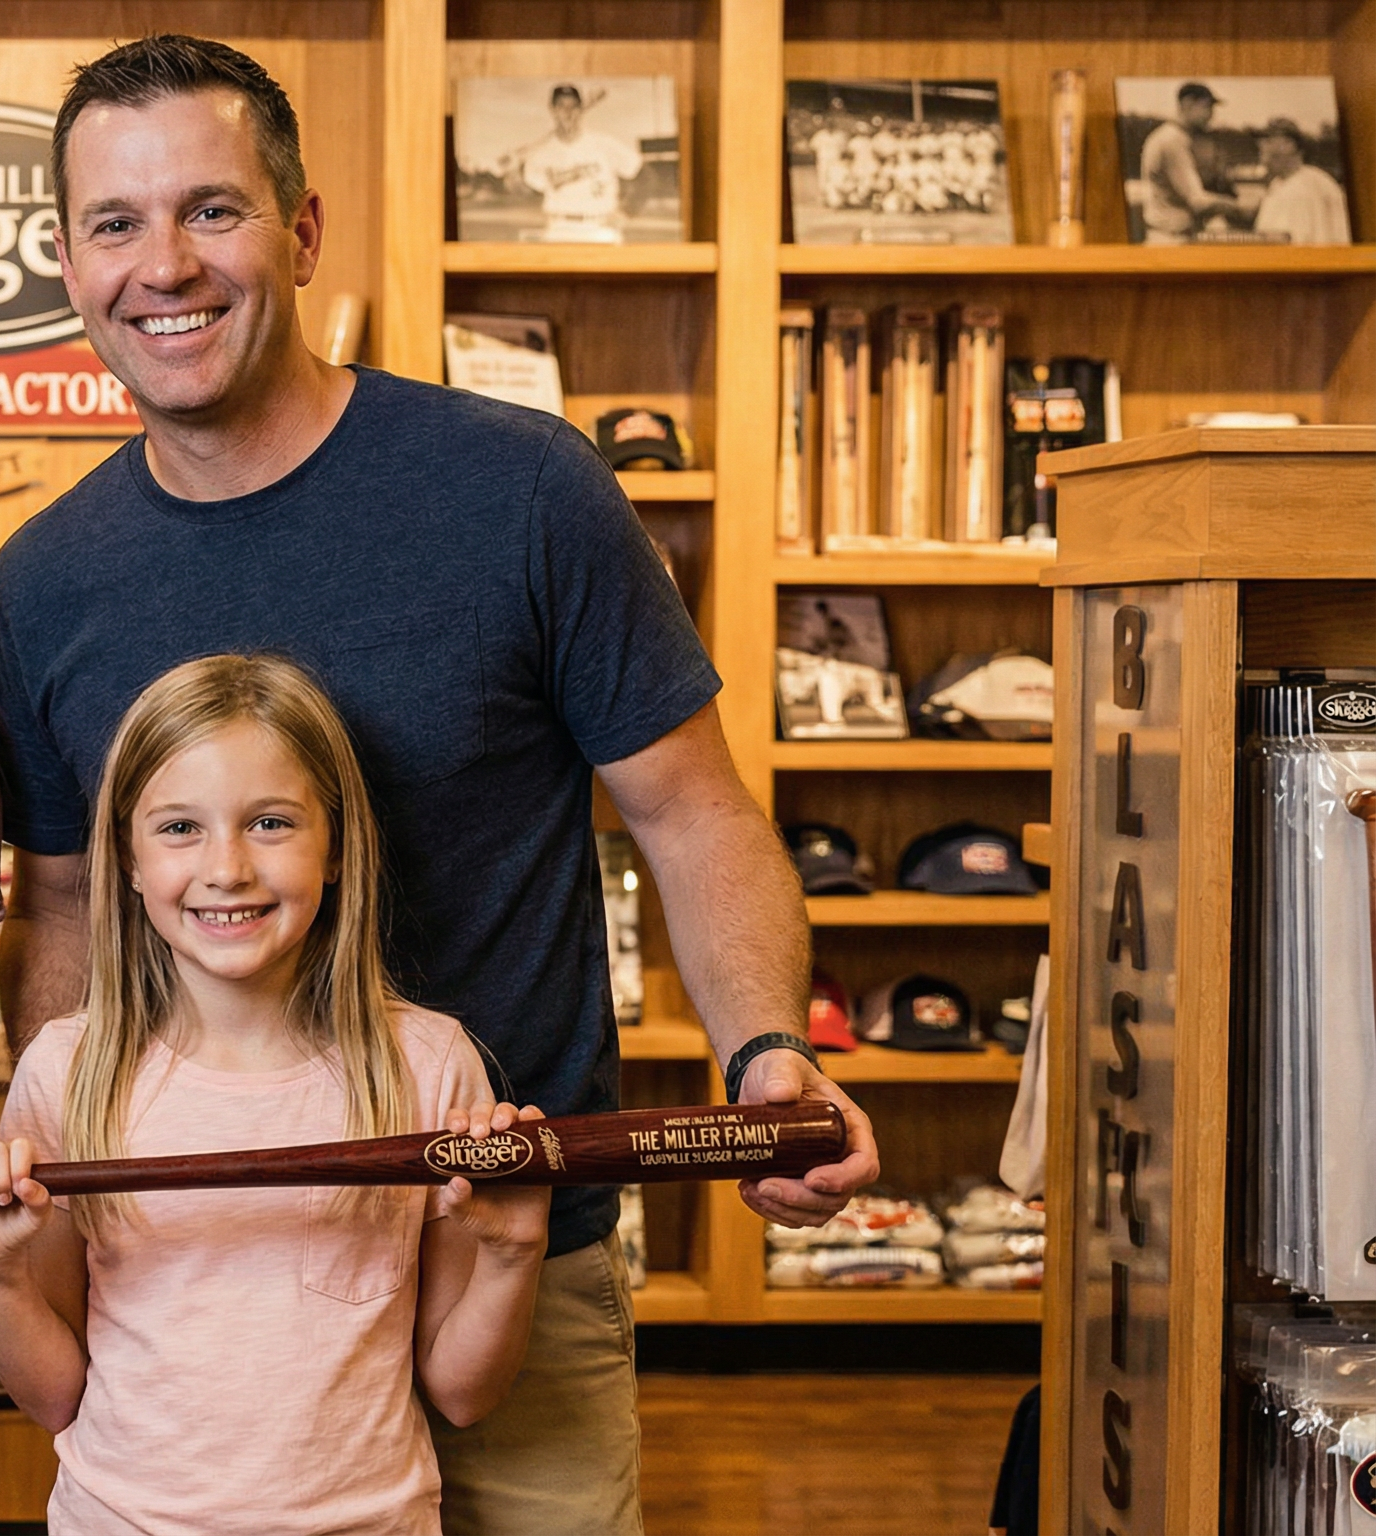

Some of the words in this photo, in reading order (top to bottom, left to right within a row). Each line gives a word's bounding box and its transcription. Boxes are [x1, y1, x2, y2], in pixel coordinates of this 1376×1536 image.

[628, 1131, 660, 1151] THE
[664, 1127, 722, 1150] MILLER
[724, 1122, 780, 1147] FAMILY
[435, 1139, 521, 1171] Slugger
